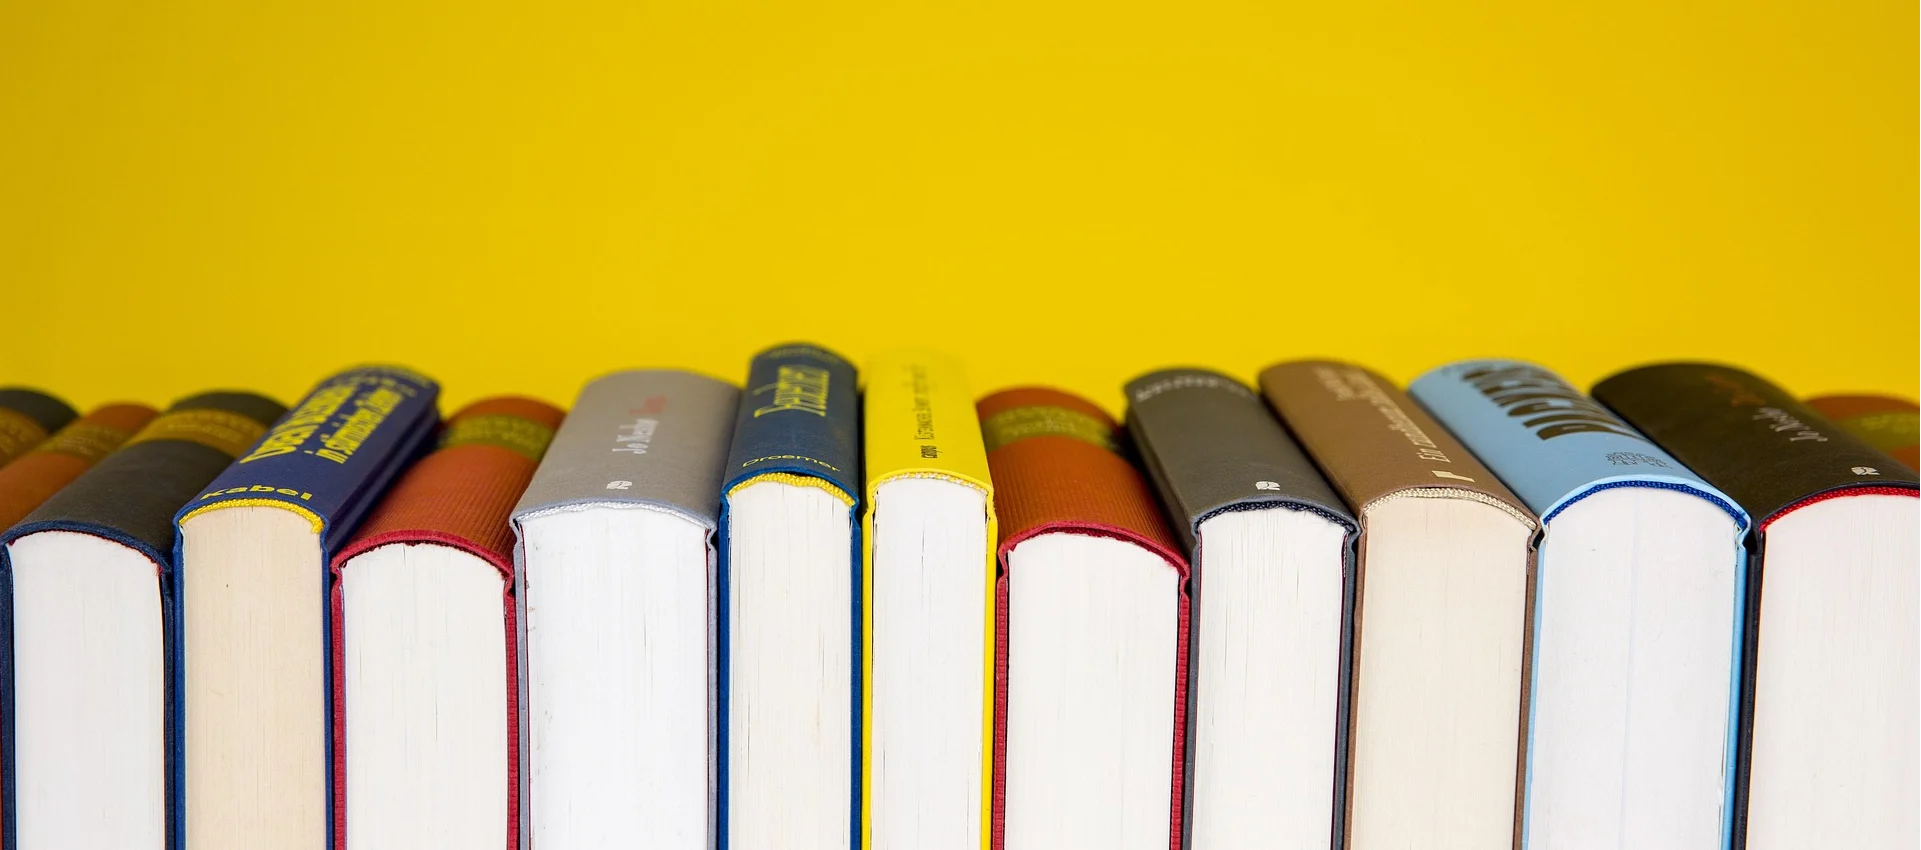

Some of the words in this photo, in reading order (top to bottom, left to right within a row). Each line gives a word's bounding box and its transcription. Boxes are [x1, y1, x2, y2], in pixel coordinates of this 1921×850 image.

[612, 442, 648, 454] Jo
[1416, 448, 1451, 463] Ein
[200, 485, 312, 500] Kabel
